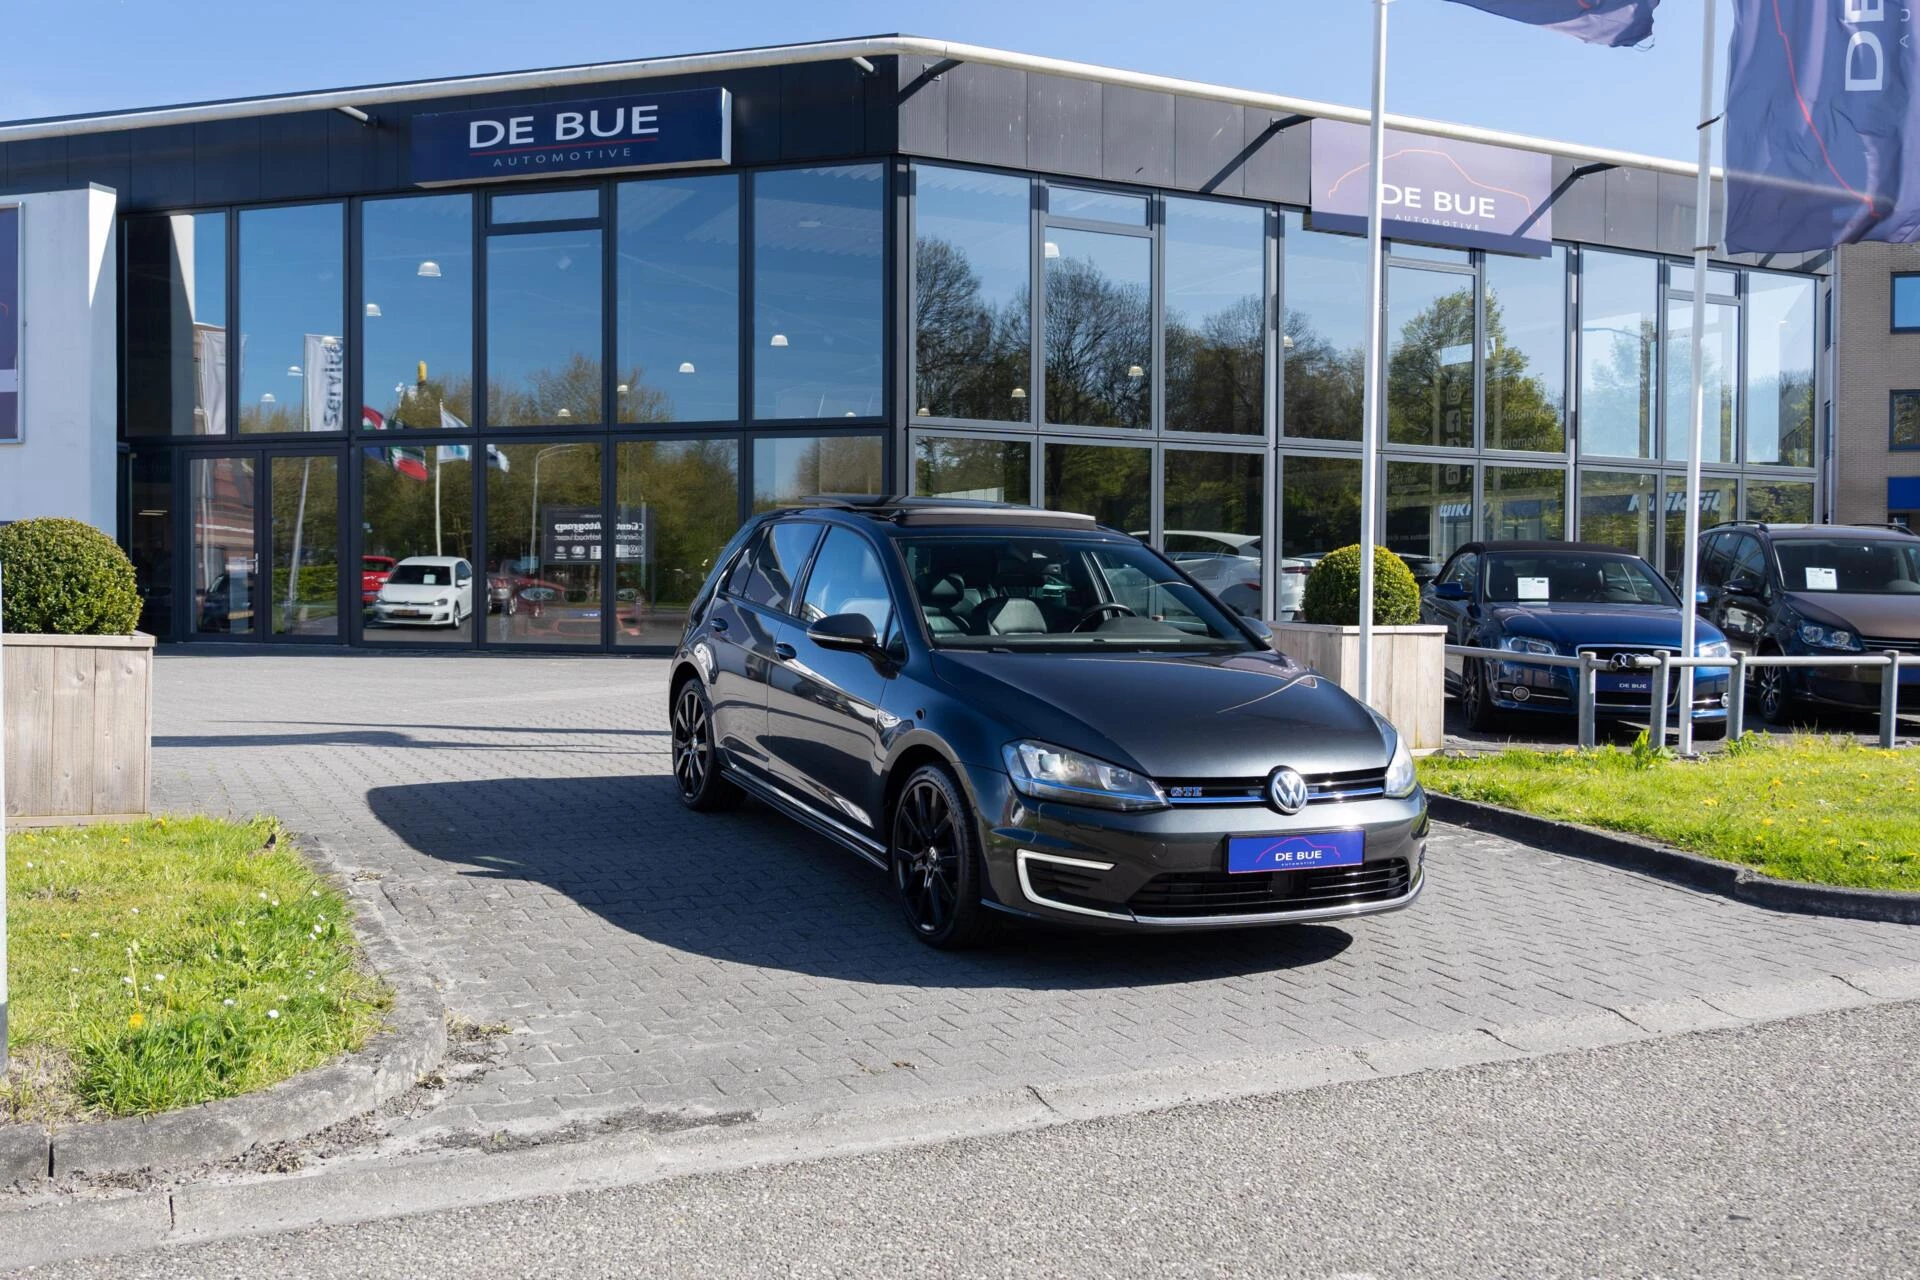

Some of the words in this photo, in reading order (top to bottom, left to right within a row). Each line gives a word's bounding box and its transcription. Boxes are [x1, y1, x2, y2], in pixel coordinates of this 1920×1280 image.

[469, 115, 535, 149] DE
[555, 104, 660, 141] BUE
[493, 147, 632, 168] AUTOMOTIVE
[1379, 183, 1422, 209] DE
[1433, 190, 1496, 219] BUE
[1394, 214, 1481, 231] AUTOMOTIVE
[1171, 786, 1202, 797] GTE
[1275, 852, 1293, 862] DE
[1297, 850, 1323, 860] BUE
